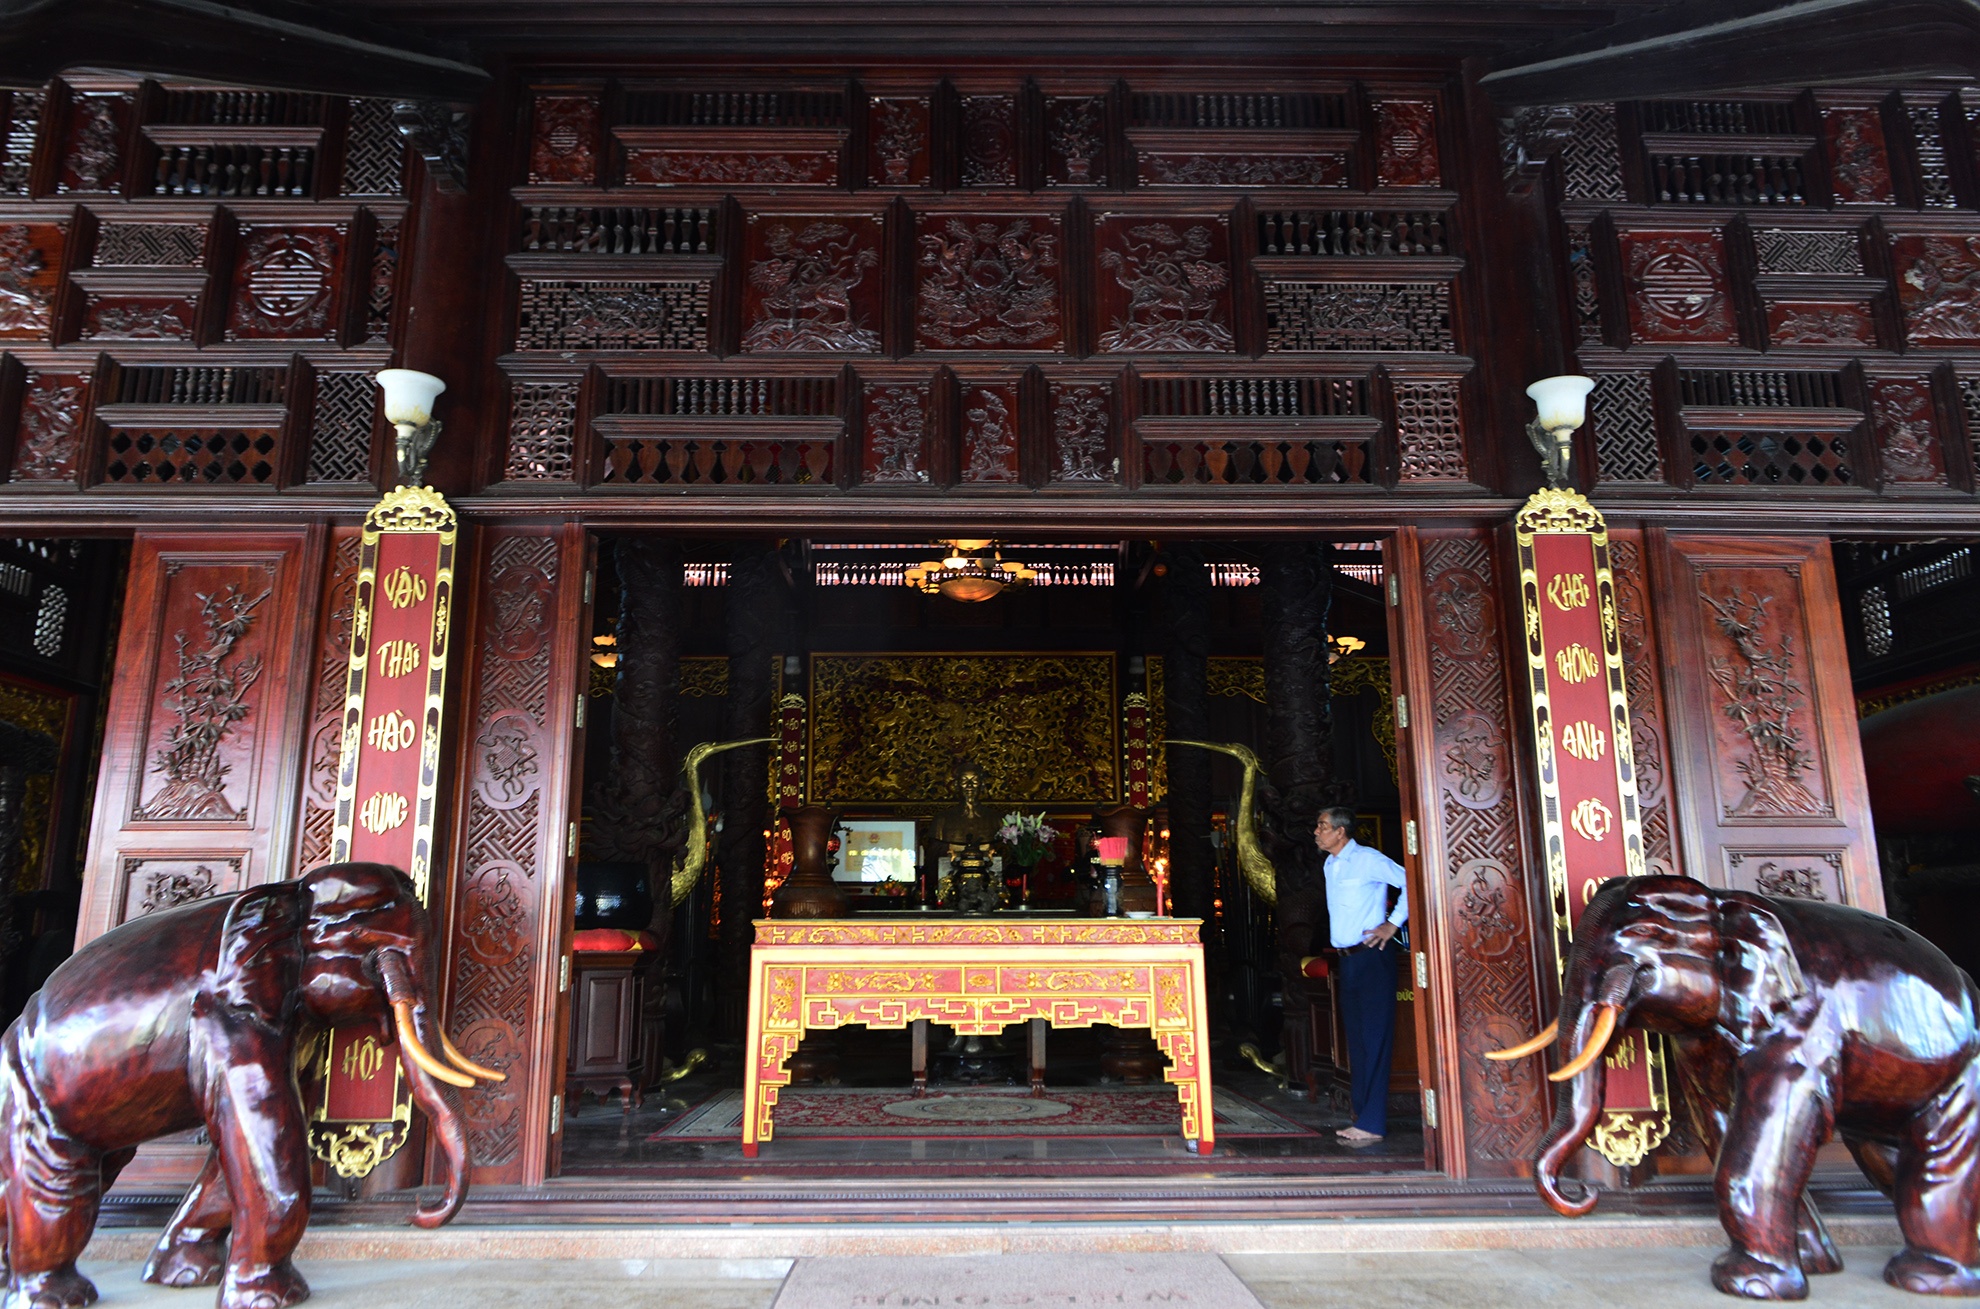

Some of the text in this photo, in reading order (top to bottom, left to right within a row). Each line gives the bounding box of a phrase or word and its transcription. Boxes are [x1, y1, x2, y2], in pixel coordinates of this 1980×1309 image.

[1555, 642, 1600, 685] THÔNG
[1561, 720, 1607, 762] ANH
[341, 565, 428, 1081] VĂN THÁI HÀO HÙNG HỘI
